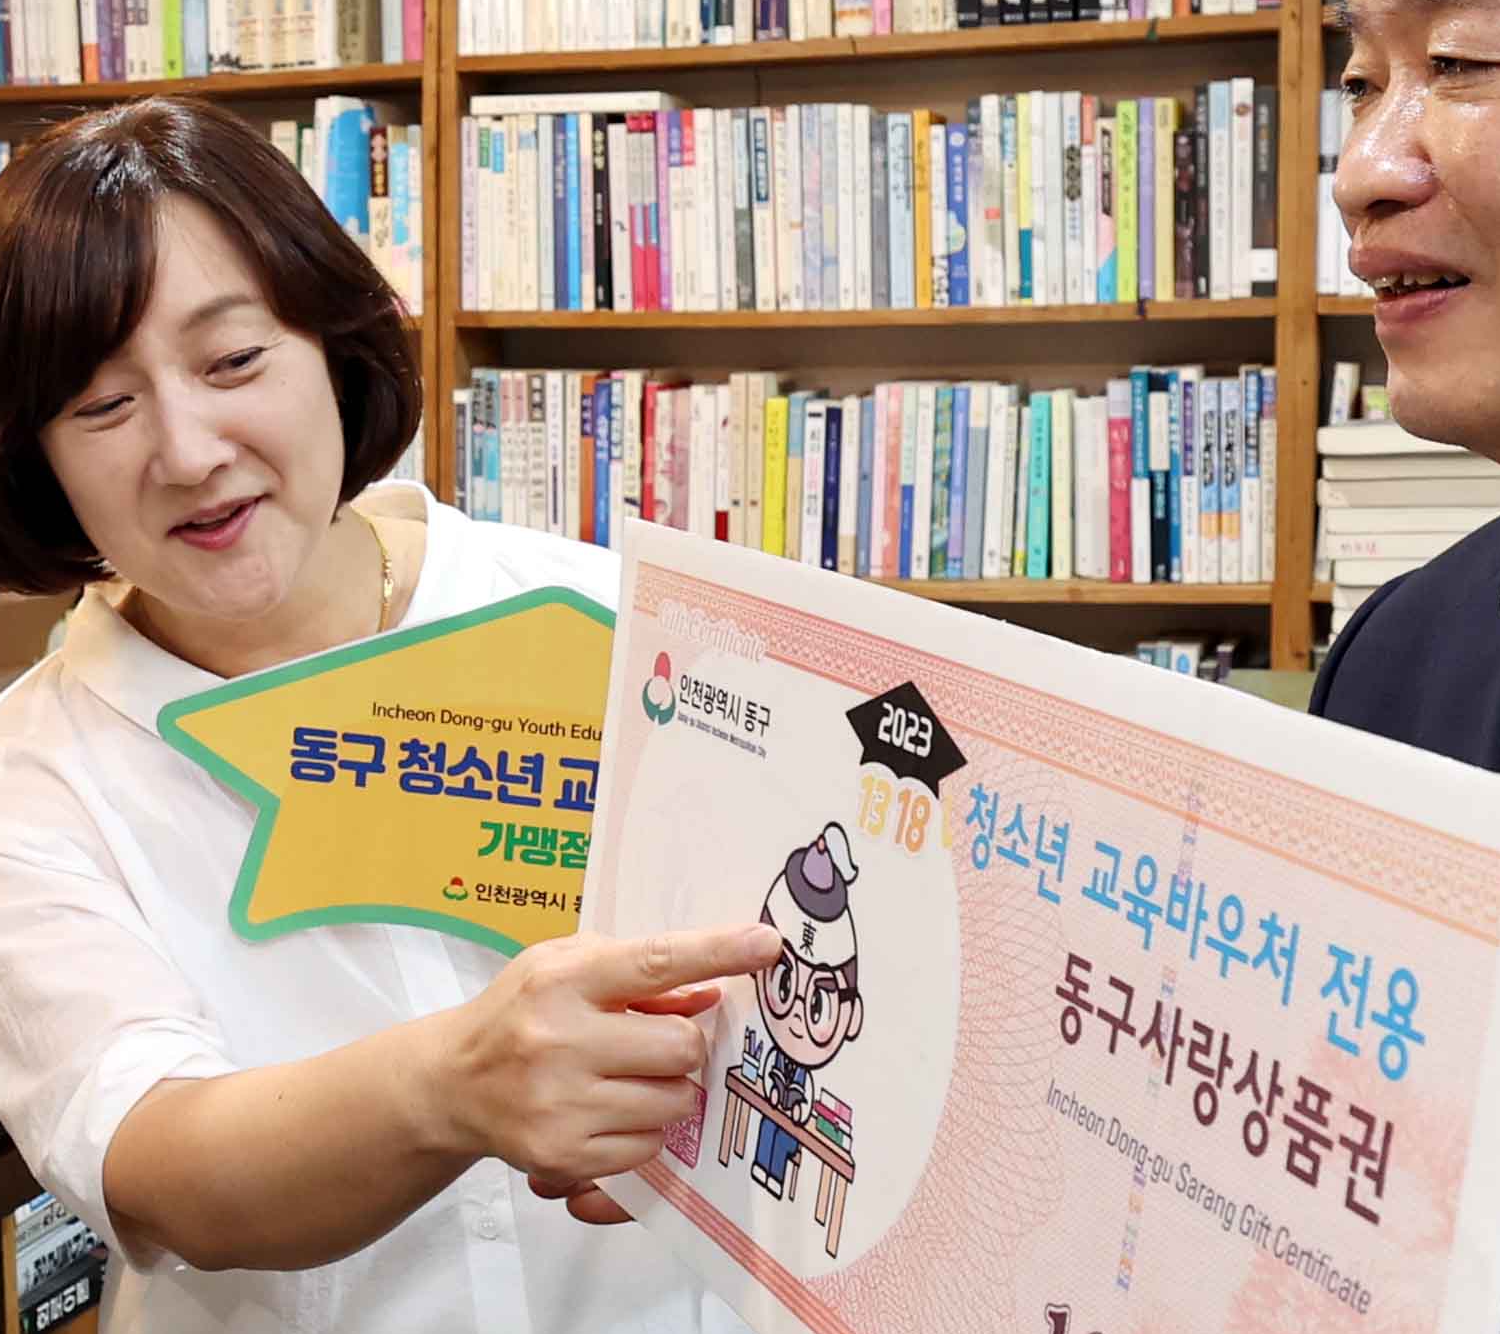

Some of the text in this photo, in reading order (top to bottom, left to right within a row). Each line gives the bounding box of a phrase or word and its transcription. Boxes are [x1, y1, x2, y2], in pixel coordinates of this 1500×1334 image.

[372, 702, 436, 724] Incheon
[441, 709, 512, 733] Dong-gu
[518, 718, 566, 738] Youth
[680, 673, 771, 738] 인천광역시 동구
[877, 701, 933, 757] 2023
[290, 727, 386, 788] 동구
[398, 738, 545, 808] 청소년
[859, 773, 931, 852] 13 18
[475, 883, 567, 912] 인천광역시
[965, 782, 1426, 1081] 청소년 교육바우처 전용
[1055, 951, 1395, 1226] 동구사랑상품권
[1046, 1077, 1372, 1316] Incheon Dong-gu Sarang Gift Certificate
